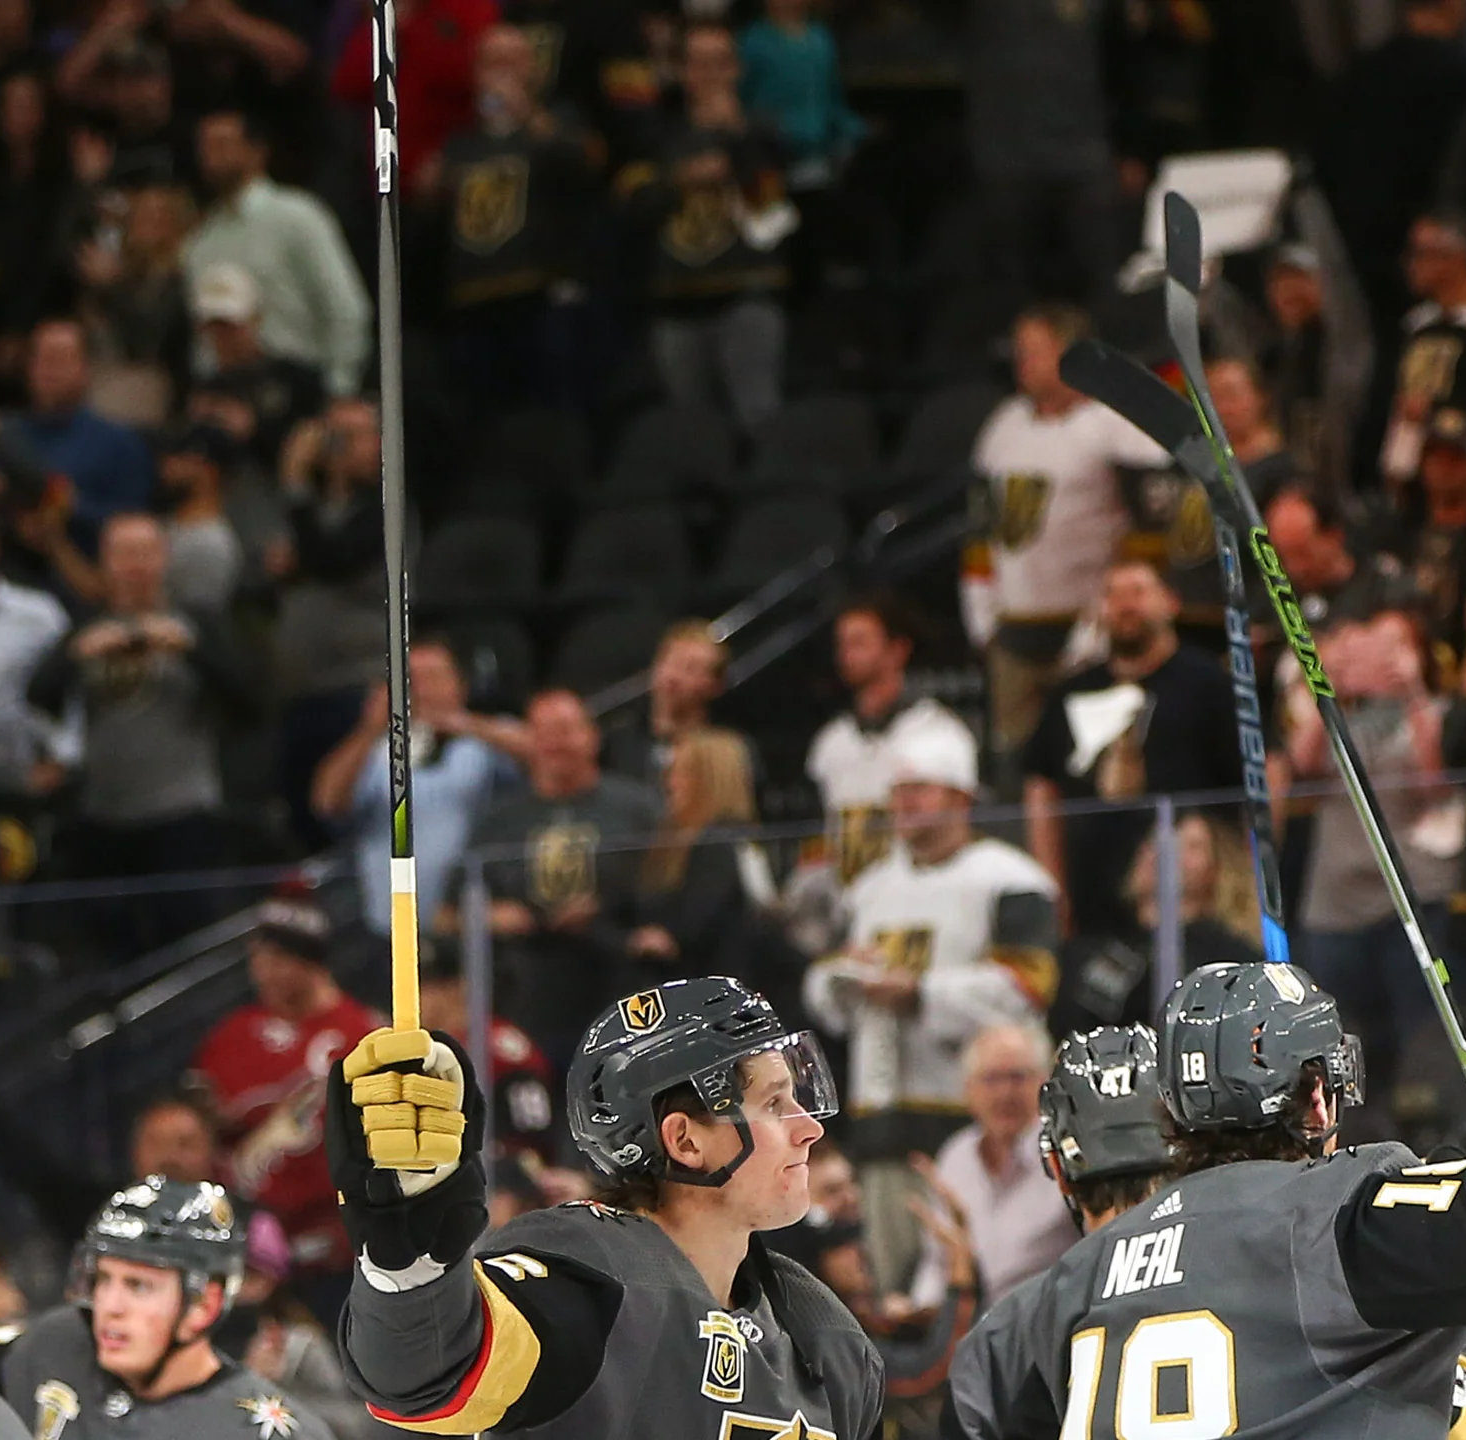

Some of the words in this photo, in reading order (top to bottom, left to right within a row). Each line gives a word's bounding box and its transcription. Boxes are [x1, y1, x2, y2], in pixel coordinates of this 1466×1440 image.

[393, 713, 406, 788] CCM
[1100, 1066, 1132, 1097] 47
[1181, 1052, 1207, 1081] 18
[1101, 1223, 1185, 1299] NEAL
